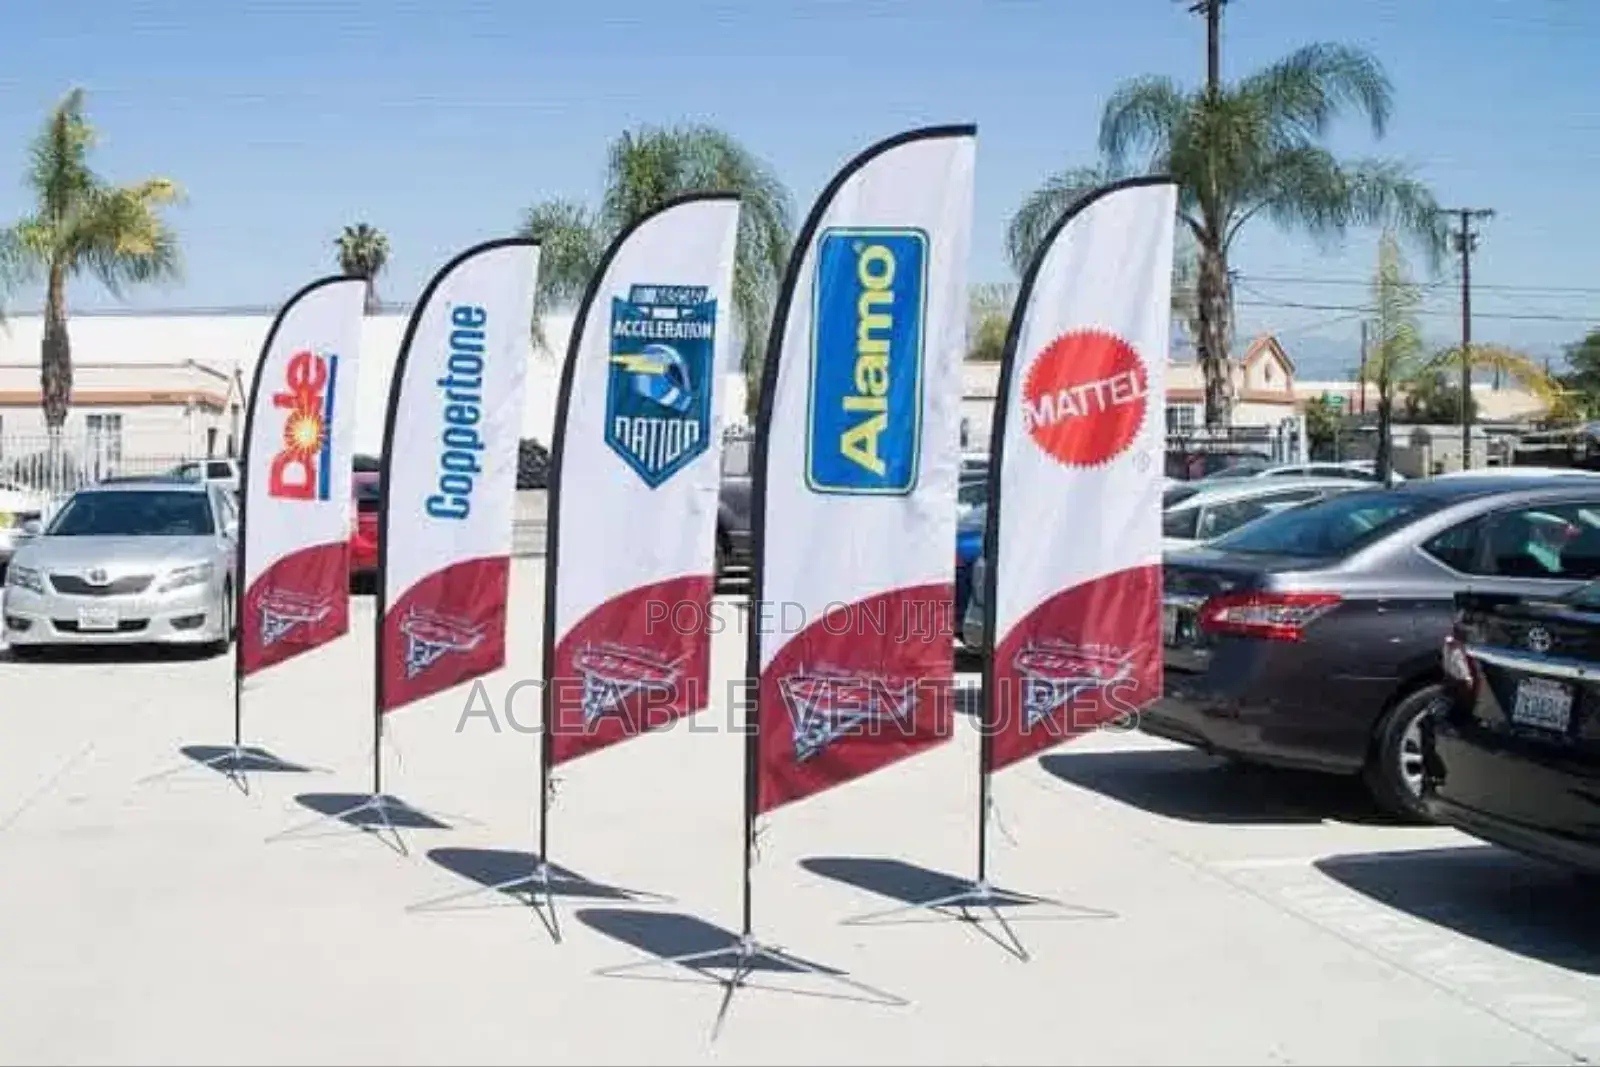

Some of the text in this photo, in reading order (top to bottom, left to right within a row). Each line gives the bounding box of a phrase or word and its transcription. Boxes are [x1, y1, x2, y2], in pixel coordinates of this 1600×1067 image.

[613, 319, 712, 340] ACCELERATION
[840, 244, 896, 477] Alamo
[1021, 368, 1149, 432] MATTEL
[268, 350, 327, 499] Dole
[425, 305, 487, 520] Coppertone
